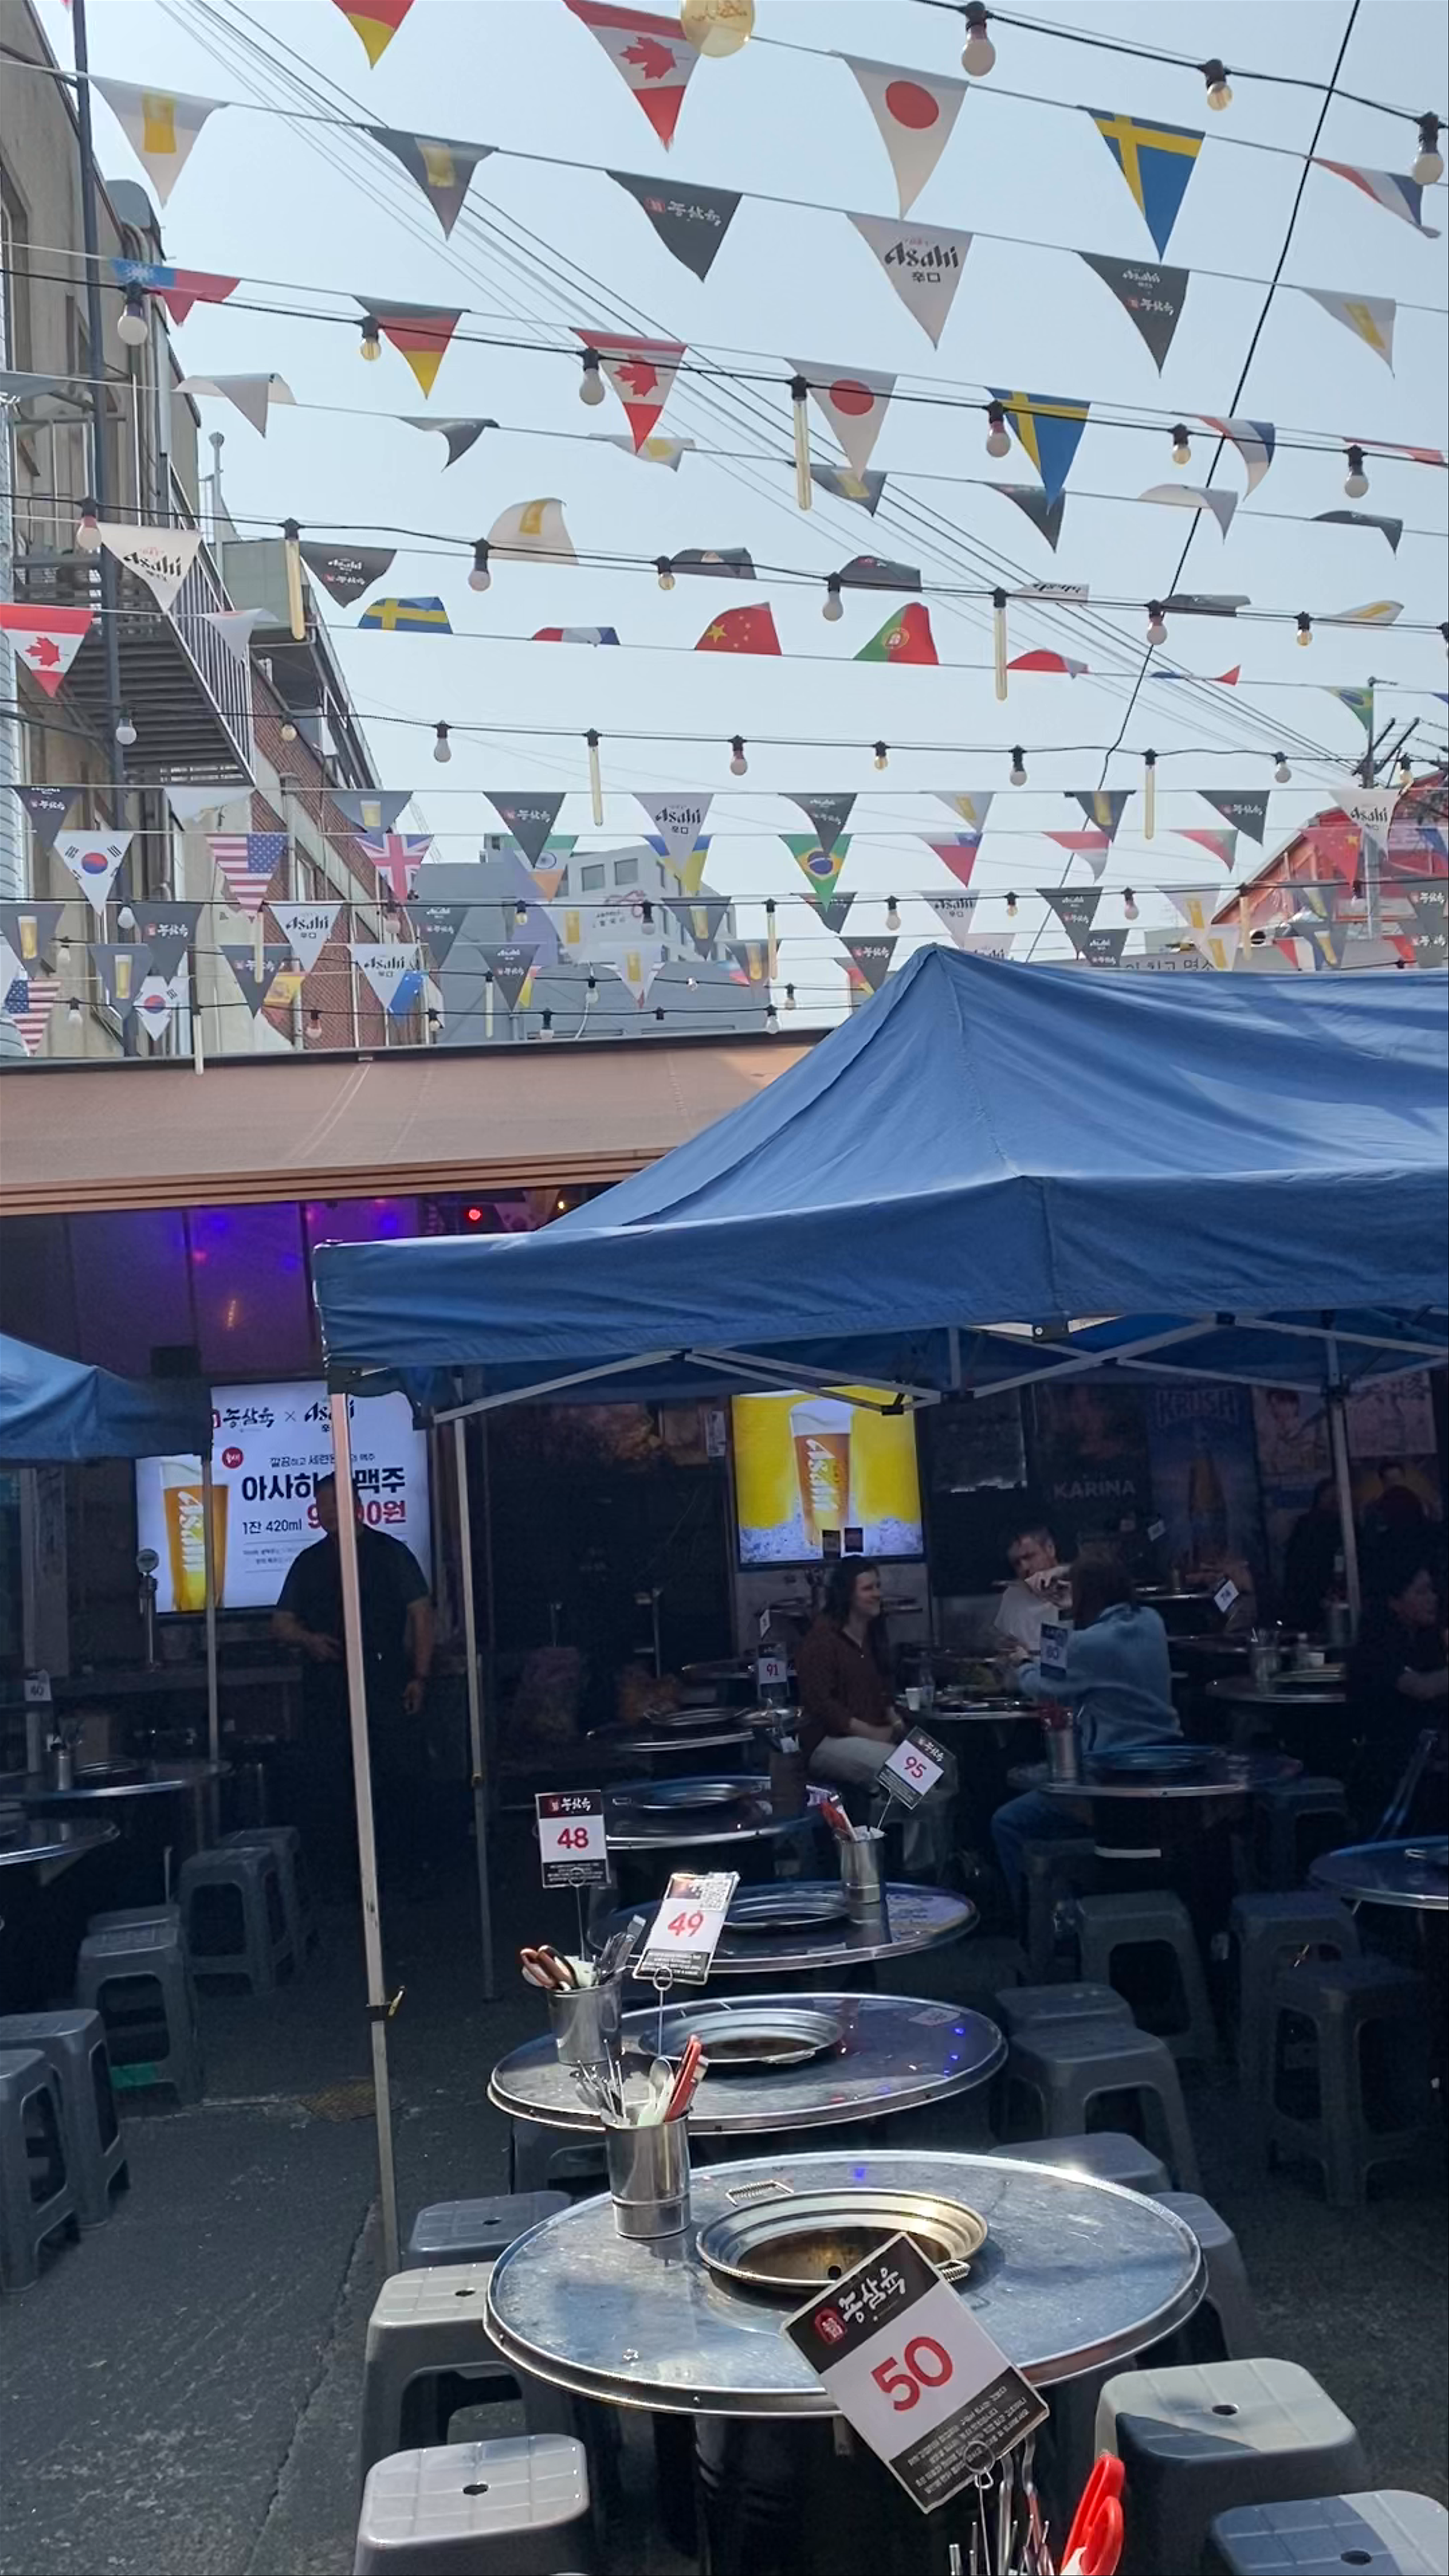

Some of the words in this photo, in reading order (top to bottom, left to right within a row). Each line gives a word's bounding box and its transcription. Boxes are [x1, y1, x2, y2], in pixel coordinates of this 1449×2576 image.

[884, 242, 959, 268] Asahi
[123, 552, 181, 577] Asahi
[655, 808, 700, 824] Asahi
[1350, 807, 1387, 821] Asahi
[286, 917, 328, 929] Asahi
[365, 956, 404, 969] Asahi
[304, 1400, 354, 1422] Asi
[1155, 1387, 1238, 1426] KRUSH
[806, 1438, 839, 1510] Asahi
[1053, 1480, 1136, 1500] KARINA
[266, 1518, 302, 1532] 420ml
[766, 1663, 779, 1676] 91
[905, 1756, 927, 1779] 95
[557, 1827, 589, 1849] 48
[668, 1910, 704, 1937] 49
[871, 2336, 953, 2411] 50
